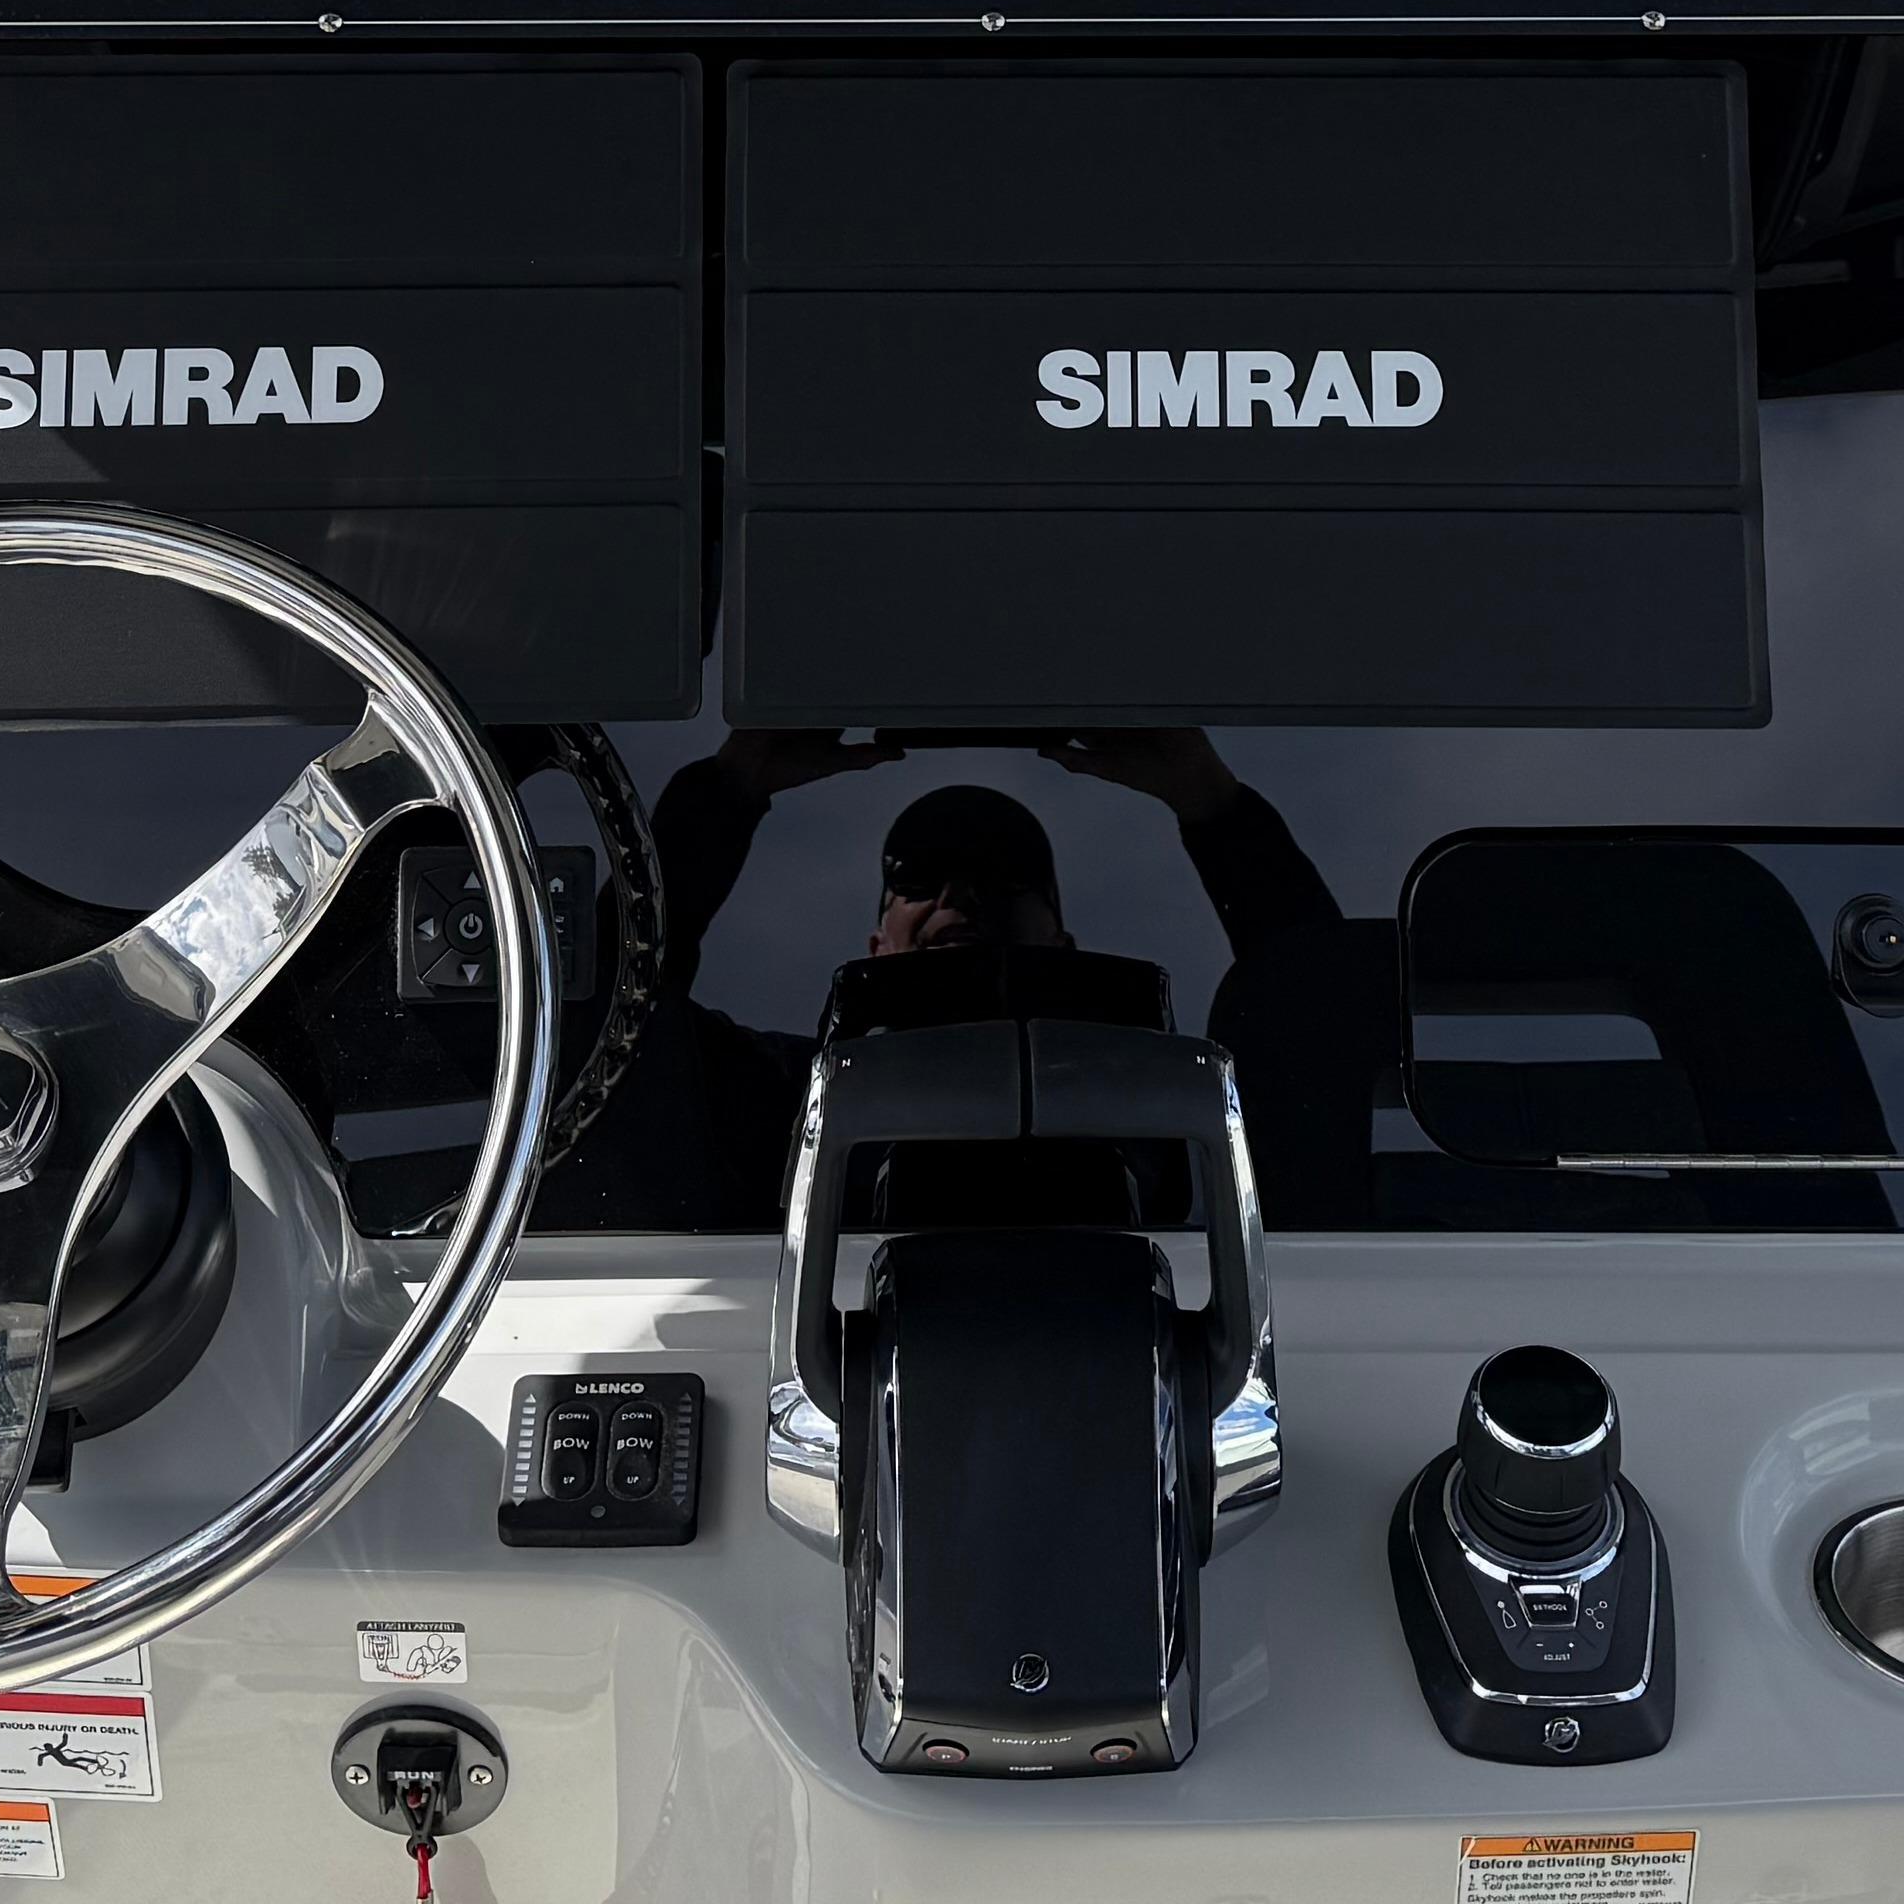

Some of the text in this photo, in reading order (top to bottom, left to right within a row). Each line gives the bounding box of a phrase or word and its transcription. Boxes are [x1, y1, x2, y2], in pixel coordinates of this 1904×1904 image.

[1035, 348, 1444, 429] SIMRAD
[589, 1382, 645, 1394] LENCO
[621, 1412, 652, 1420] DOWN
[553, 1437, 590, 1450] BOW
[616, 1437, 654, 1450] BOW
[563, 1476, 575, 1485] UP
[626, 1476, 639, 1484] UP
[38, 1724, 77, 1732] INJURY
[394, 1771, 434, 1780] RUN
[1543, 1836, 1634, 1852] WARNING
[1469, 1853, 1686, 1869] Before activating Skyhook:
[1482, 1873, 1518, 1882] Check
[1522, 1872, 1543, 1880] that
